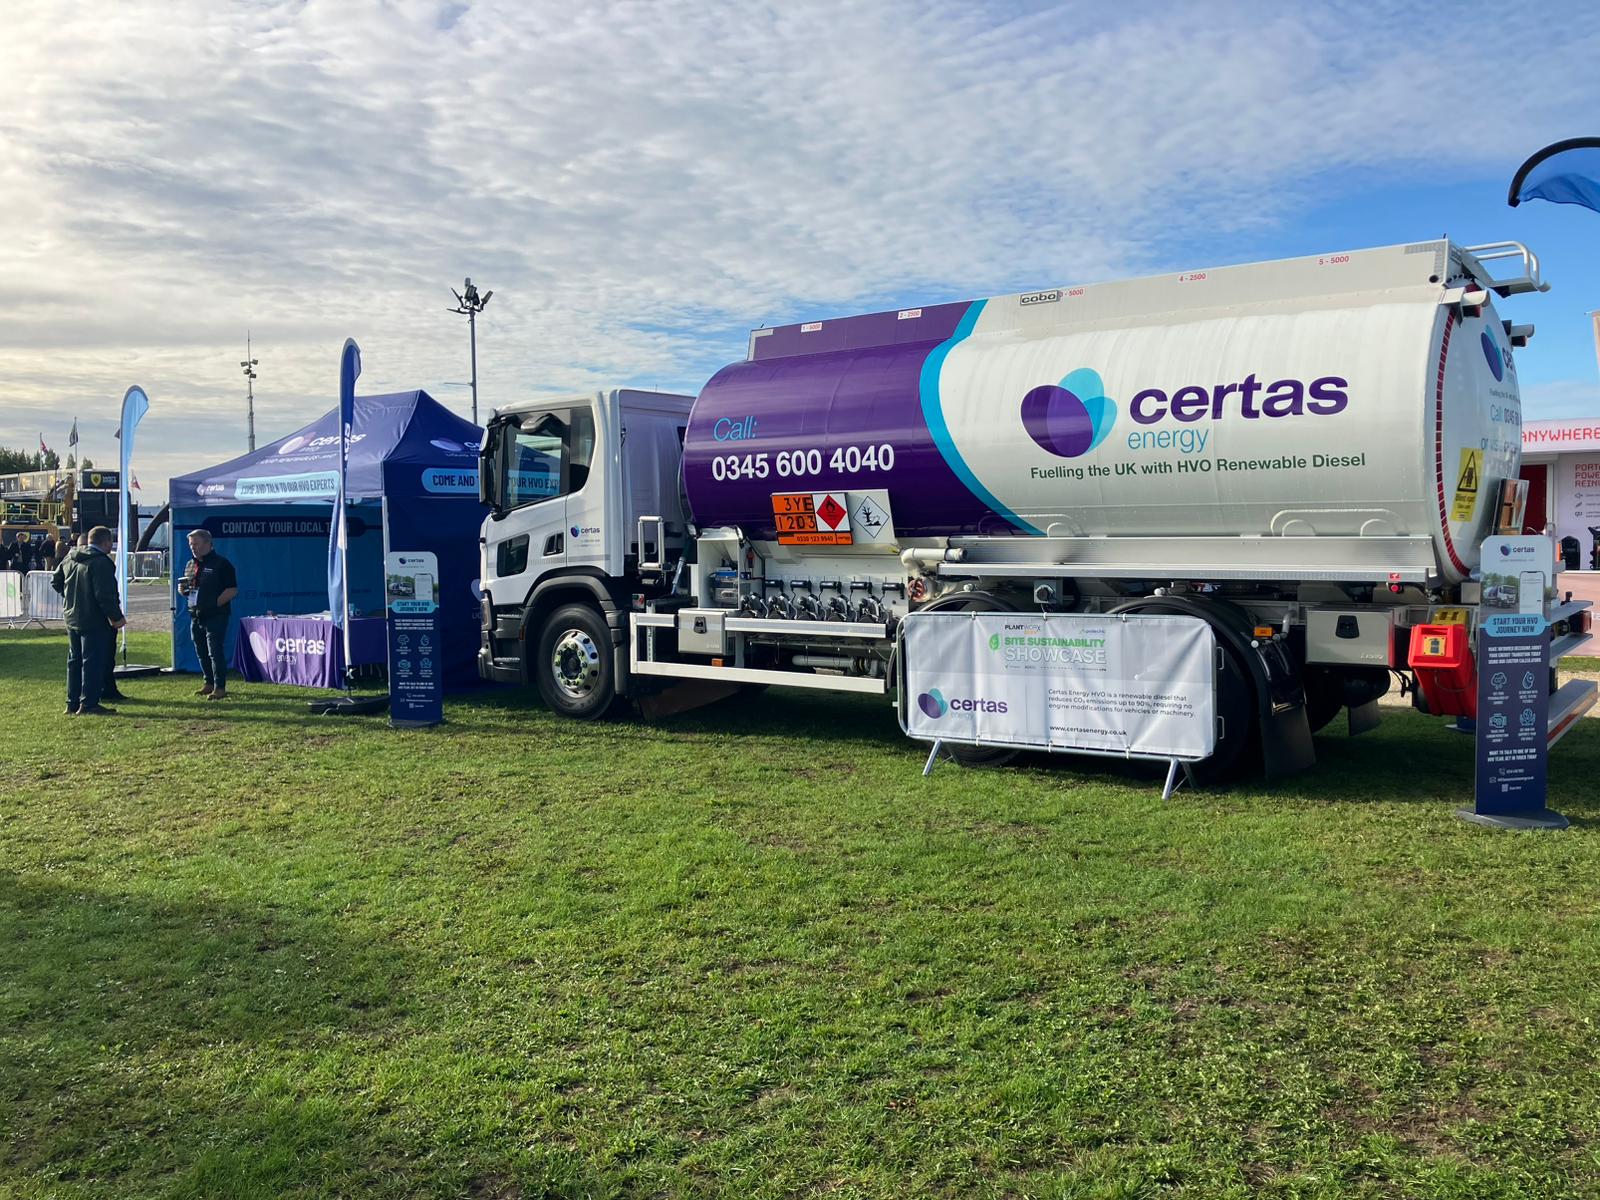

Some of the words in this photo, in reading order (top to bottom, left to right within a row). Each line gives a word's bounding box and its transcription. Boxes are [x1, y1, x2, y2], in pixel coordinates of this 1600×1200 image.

[1330, 255, 1350, 265] 5000
[1189, 273, 1207, 281] 2500
[1021, 291, 1057, 304] cobo
[1068, 288, 1084, 297] 5000
[1129, 373, 1348, 425] certas
[713, 416, 757, 442] Call:
[1127, 427, 1209, 453] energy
[712, 453, 769, 481] 0345
[776, 449, 822, 477] 600
[829, 443, 895, 473] 4040
[1030, 465, 1085, 481] Fuelling
[1087, 463, 1110, 477] the
[1114, 462, 1138, 476] UK
[1141, 460, 1173, 475] with
[1177, 458, 1212, 474] HVO
[1217, 454, 1307, 471] Renewable
[1312, 451, 1366, 468] Diesel
[310, 478, 335, 492] EXPERTS
[432, 475, 456, 487] COME
[458, 475, 475, 487] AND
[784, 496, 814, 512] 3YE
[222, 521, 266, 534] CONTACT
[269, 521, 293, 534] YOUR
[295, 521, 324, 534] LOCAL
[581, 526, 600, 534] certas
[1512, 545, 1535, 553] certas
[1493, 617, 1510, 625] START
[1512, 617, 1526, 625] YOUR
[1526, 616, 1538, 625] HVO
[1522, 625, 1535, 633] NOW
[275, 636, 326, 655] certas
[1005, 637, 1025, 646] SITE
[1027, 637, 1106, 648] SUSTAINABILITY
[1005, 647, 1107, 665] SHOWCASE
[1069, 690, 1090, 698] Energy
[1119, 692, 1151, 700] renewable
[1153, 693, 1173, 701] diesel
[950, 698, 1008, 713] certas
[1048, 695, 1073, 703] reduces
[1086, 698, 1118, 706] emissions
[1153, 701, 1182, 710] requiring
[1048, 703, 1070, 711] engine
[1070, 704, 1113, 712] modifications
[1124, 706, 1151, 714] vehicles
[1049, 725, 1128, 736] www.certasenergy.co.uk
